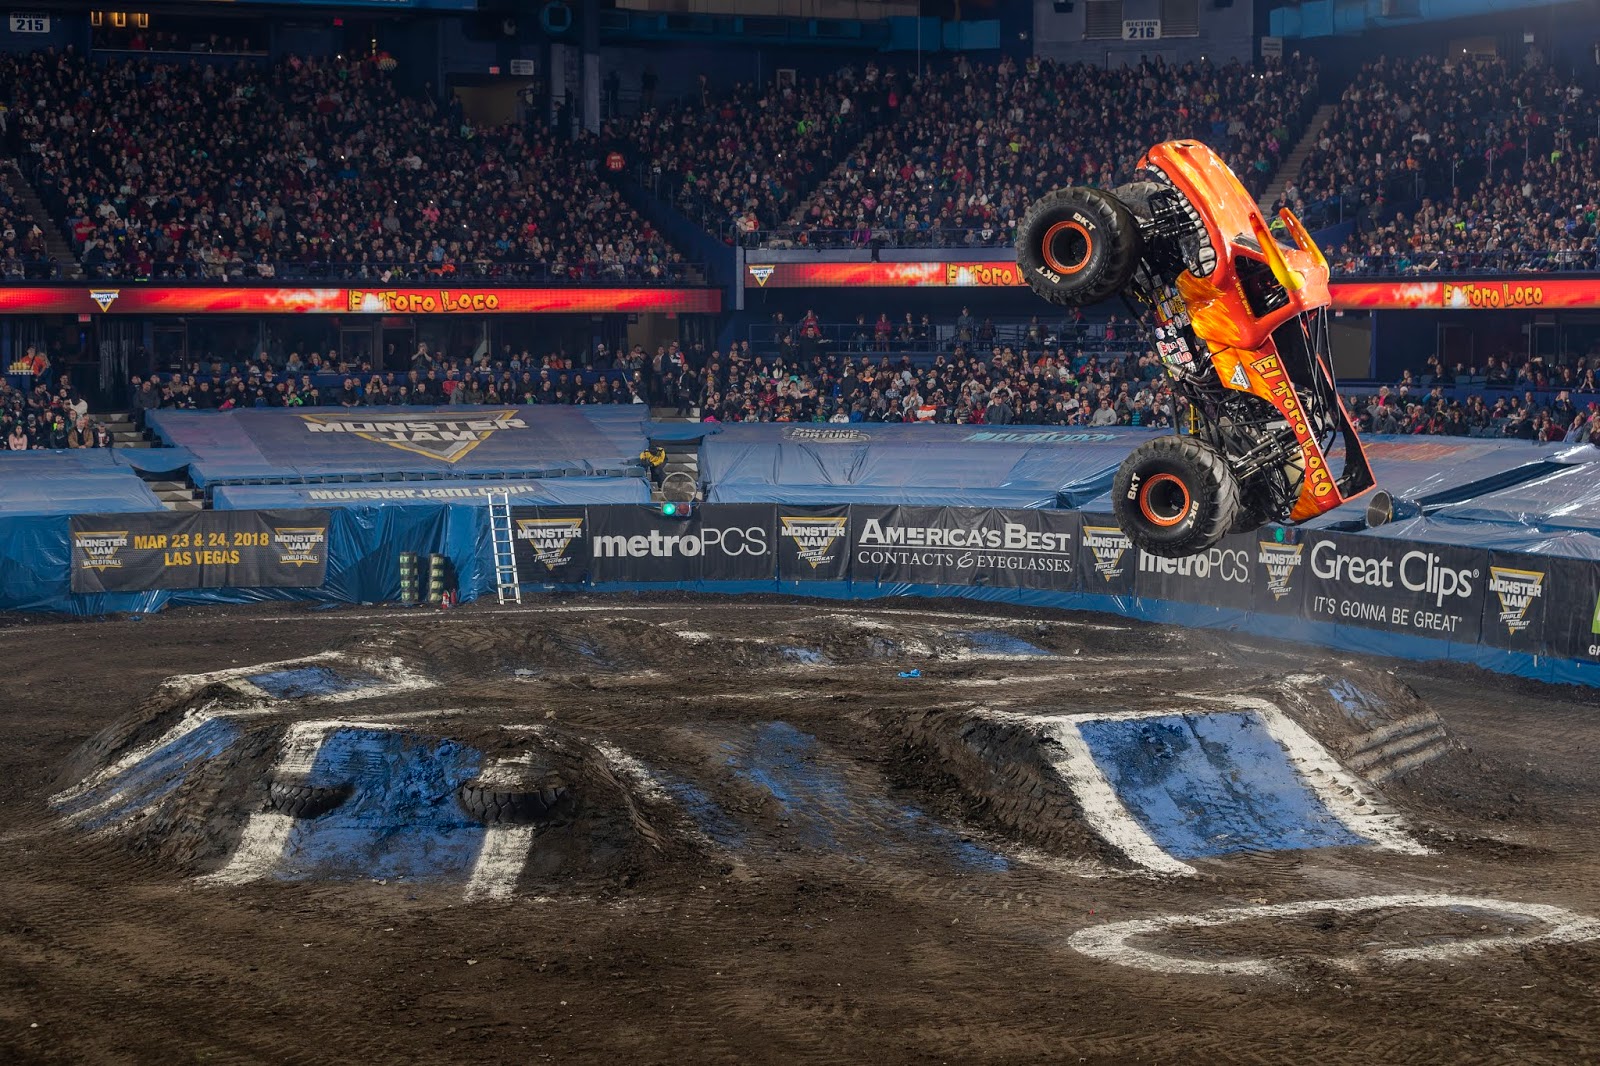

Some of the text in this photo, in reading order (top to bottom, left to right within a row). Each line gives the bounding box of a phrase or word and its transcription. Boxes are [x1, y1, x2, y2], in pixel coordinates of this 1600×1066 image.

[16, 19, 44, 31] 215
[1128, 27, 1155, 38] 216
[1072, 211, 1097, 231] BKT
[1034, 265, 1061, 284] BKT
[303, 419, 530, 433] MONSTER
[378, 430, 479, 442] JAM
[1127, 473, 1140, 500] BKT
[1186, 500, 1200, 528] BKT
[517, 529, 582, 539] MONSTER
[781, 526, 845, 536] MONSTER
[858, 518, 1071, 551] AMERICA'S BEST
[76, 539, 127, 547] MONSTER
[134, 533, 269, 549] MAR 23 & 24, 2018
[536, 539, 564, 548] JAM
[593, 527, 767, 557] metroPCS
[800, 537, 828, 546] JAM
[1082, 536, 1132, 549] MONSTER
[164, 551, 240, 566] LAS VEGAS
[533, 550, 560, 562] TRIPLE
[796, 549, 825, 560] TRIPLE
[805, 555, 835, 563] THREAT
[1096, 548, 1118, 558] JAM
[1259, 552, 1302, 566] MONSTER
[858, 551, 1073, 573] CONTACTS & EYEGLASSES
[1094, 561, 1115, 572] TRIPLE
[1310, 540, 1393, 588] Great
[1271, 565, 1289, 576] JAM
[1489, 579, 1542, 597] MONSTER
[1502, 594, 1527, 608] JAM
[1313, 595, 1337, 615] IT'S
[1340, 599, 1387, 622] GONNA
[1391, 606, 1410, 626] BE
[1499, 611, 1522, 622] TRIPLE
[1506, 619, 1530, 627] THREAT
